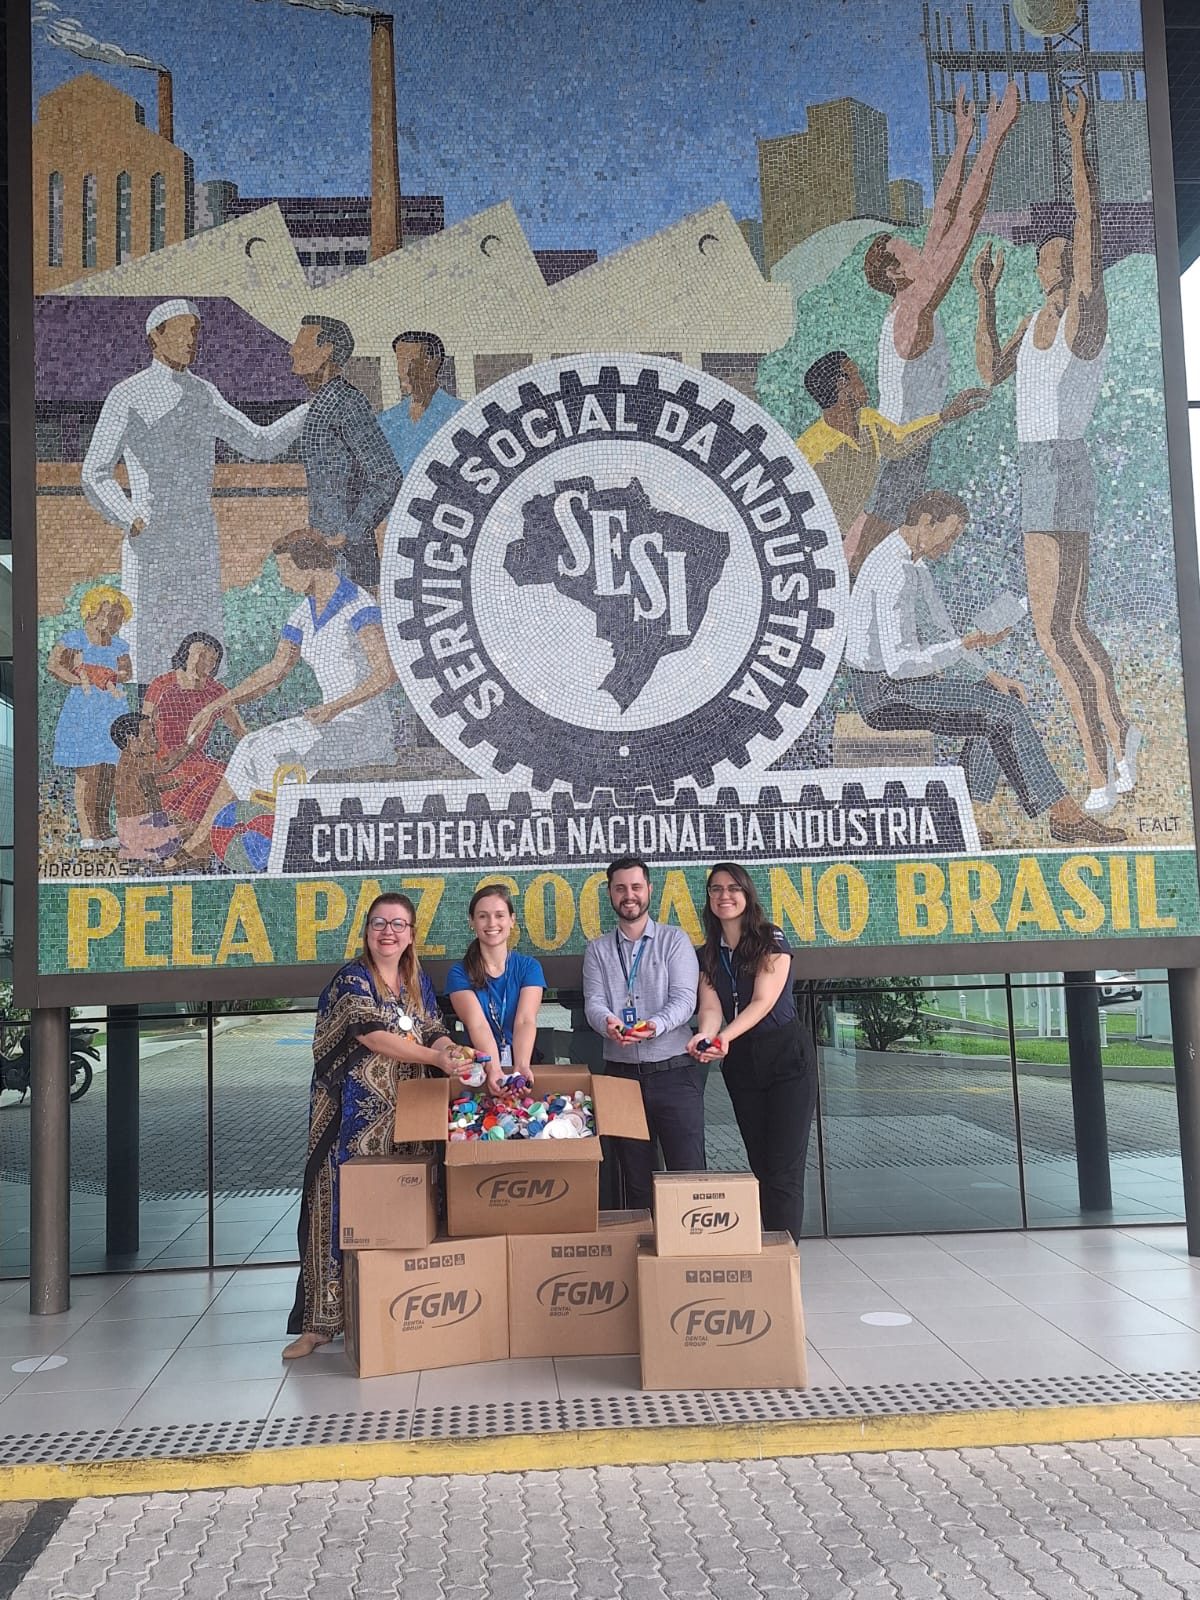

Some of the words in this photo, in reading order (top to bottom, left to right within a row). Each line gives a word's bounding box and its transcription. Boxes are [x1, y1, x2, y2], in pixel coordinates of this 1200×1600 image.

[460, 393, 639, 496] SOCIAL
[654, 402, 719, 463] DA
[553, 489, 691, 636] SESI
[719, 449, 811, 713] INDÚSTRIA
[422, 503, 505, 720] SERVIÇO
[312, 811, 556, 863] CONFEDERAÇÃO
[567, 813, 716, 855] NACIONAL
[724, 811, 765, 851] DA
[774, 800, 939, 850] INDÚSTRIA
[66, 883, 275, 969] PELA
[768, 862, 870, 943] NO
[895, 854, 1178, 937] BRASIL
[490, 1179, 555, 1200] FGM
[690, 1212, 730, 1228] FGM
[404, 1290, 468, 1321] FGM
[551, 1280, 615, 1306] FGM
[686, 1309, 756, 1335] FGM
